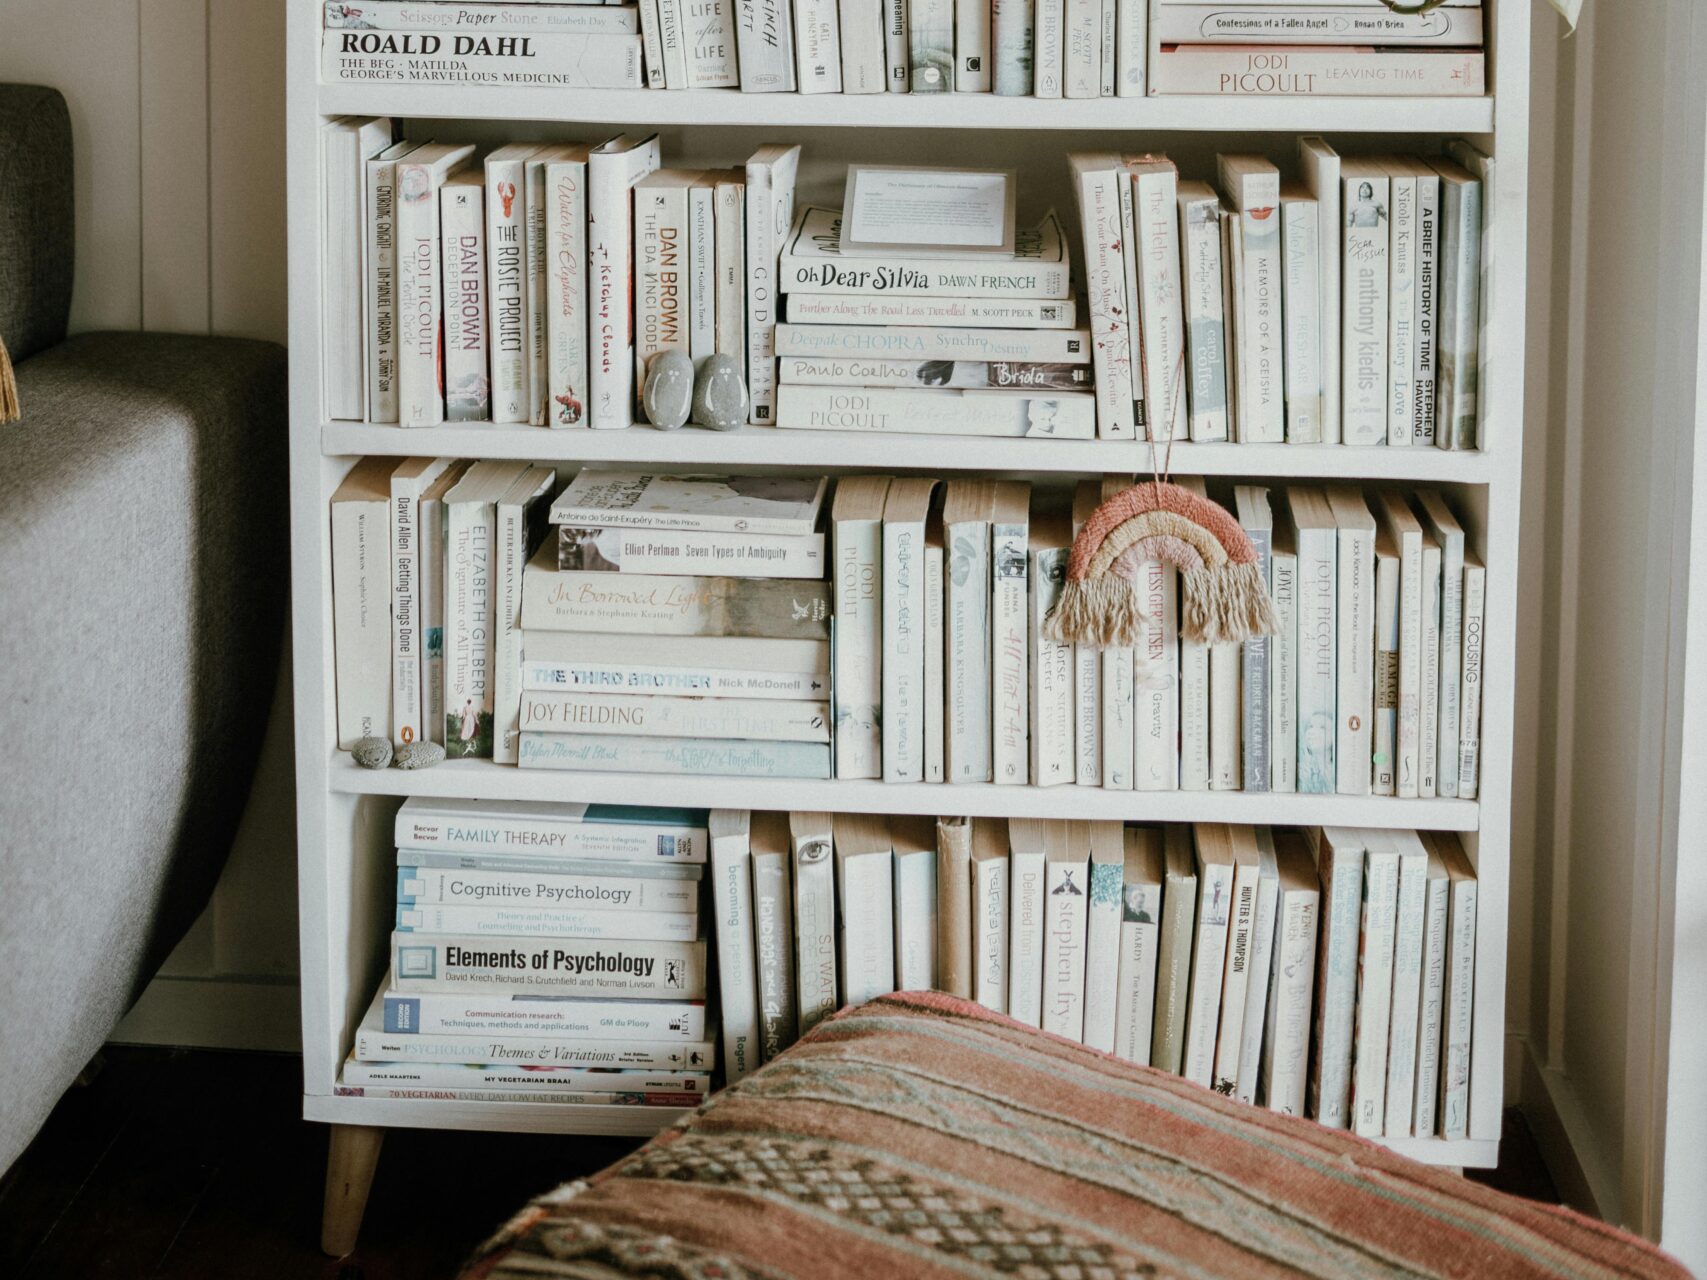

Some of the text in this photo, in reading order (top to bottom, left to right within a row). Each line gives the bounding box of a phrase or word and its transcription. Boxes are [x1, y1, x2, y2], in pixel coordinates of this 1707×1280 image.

[400, 10, 538, 25] Scissors Paper Stone
[691, 3, 721, 17] LIFE
[891, 0, 904, 36] meaning
[1216, 20, 1262, 28] Confessions
[1264, 20, 1272, 28] of
[1281, 19, 1304, 28] Fallen
[1306, 19, 1328, 29] Angel
[339, 33, 536, 57] ROALD DAHL
[695, 45, 725, 59] LIFE
[340, 59, 467, 70] THE BFG MATILDA
[340, 69, 569, 84] GEORGE'S MARVELLOUS MEDICINE
[1247, 55, 1288, 71] JODI
[1326, 68, 1424, 79] LEAVING TIME
[1220, 74, 1317, 92] PICOULT
[1150, 192, 1168, 260] The Help
[1397, 186, 1410, 274] Nicole Krauss
[555, 177, 577, 316] Water for Elephants
[447, 238, 460, 351] DECEPTION POINT
[460, 236, 479, 350] DAN BROWN
[644, 215, 658, 351] THE DA VINCI CODE
[660, 228, 678, 342] DAN BROWN
[754, 267, 767, 322] GOD
[821, 265, 870, 287] Dear
[873, 267, 929, 289] Silvia
[939, 275, 976, 288] DAWN
[981, 275, 1035, 289] FRENCH
[1420, 208, 1431, 371] A BRIEF HISTORY OF TIME
[416, 238, 432, 359] JODI PICOULT
[1206, 329, 1220, 363] carol
[1258, 258, 1270, 405] MEMOIRS OF A GEISHA
[1353, 268, 1382, 390] anthony kiedis
[795, 362, 908, 377] Paulo Coelho
[993, 364, 1044, 384] Brida
[1196, 346, 1210, 398] coffey
[811, 412, 888, 428] PICOULT
[829, 396, 870, 410] JODI
[1414, 380, 1423, 437] HAWKING
[1424, 380, 1433, 437] STEPHEN
[398, 498, 411, 550] David Allen
[625, 543, 680, 556] Elliot Perlman
[686, 545, 786, 560] Seven Types of Ambiguity
[844, 547, 857, 619] PICOULT
[860, 563, 873, 599] JODI
[1277, 567, 1291, 604] JOYCE
[397, 558, 412, 652] Getting Things Done
[472, 526, 486, 699] ELIZABETH GILBERT
[1466, 616, 1479, 683] FOCUSING
[525, 702, 645, 726] JOY FIELDING
[1150, 693, 1163, 739] Gravity
[414, 833, 438, 841] Becvar
[447, 828, 567, 846] FAMILY THERAPY
[450, 881, 531, 900] Cognitive
[536, 884, 632, 904] Psychology
[728, 865, 741, 927] becoming
[1134, 927, 1143, 962] HARDY
[1233, 887, 1252, 972] HUNTER S. THOMPSON
[446, 947, 655, 978] Elements of Psychology
[1051, 902, 1077, 1019] stephen fry
[441, 1020, 589, 1033] Techniques, methods and applications
[465, 1010, 564, 1020] Communication research:
[489, 1045, 615, 1061] Themes & Variations
[735, 1036, 746, 1072] Rogers
